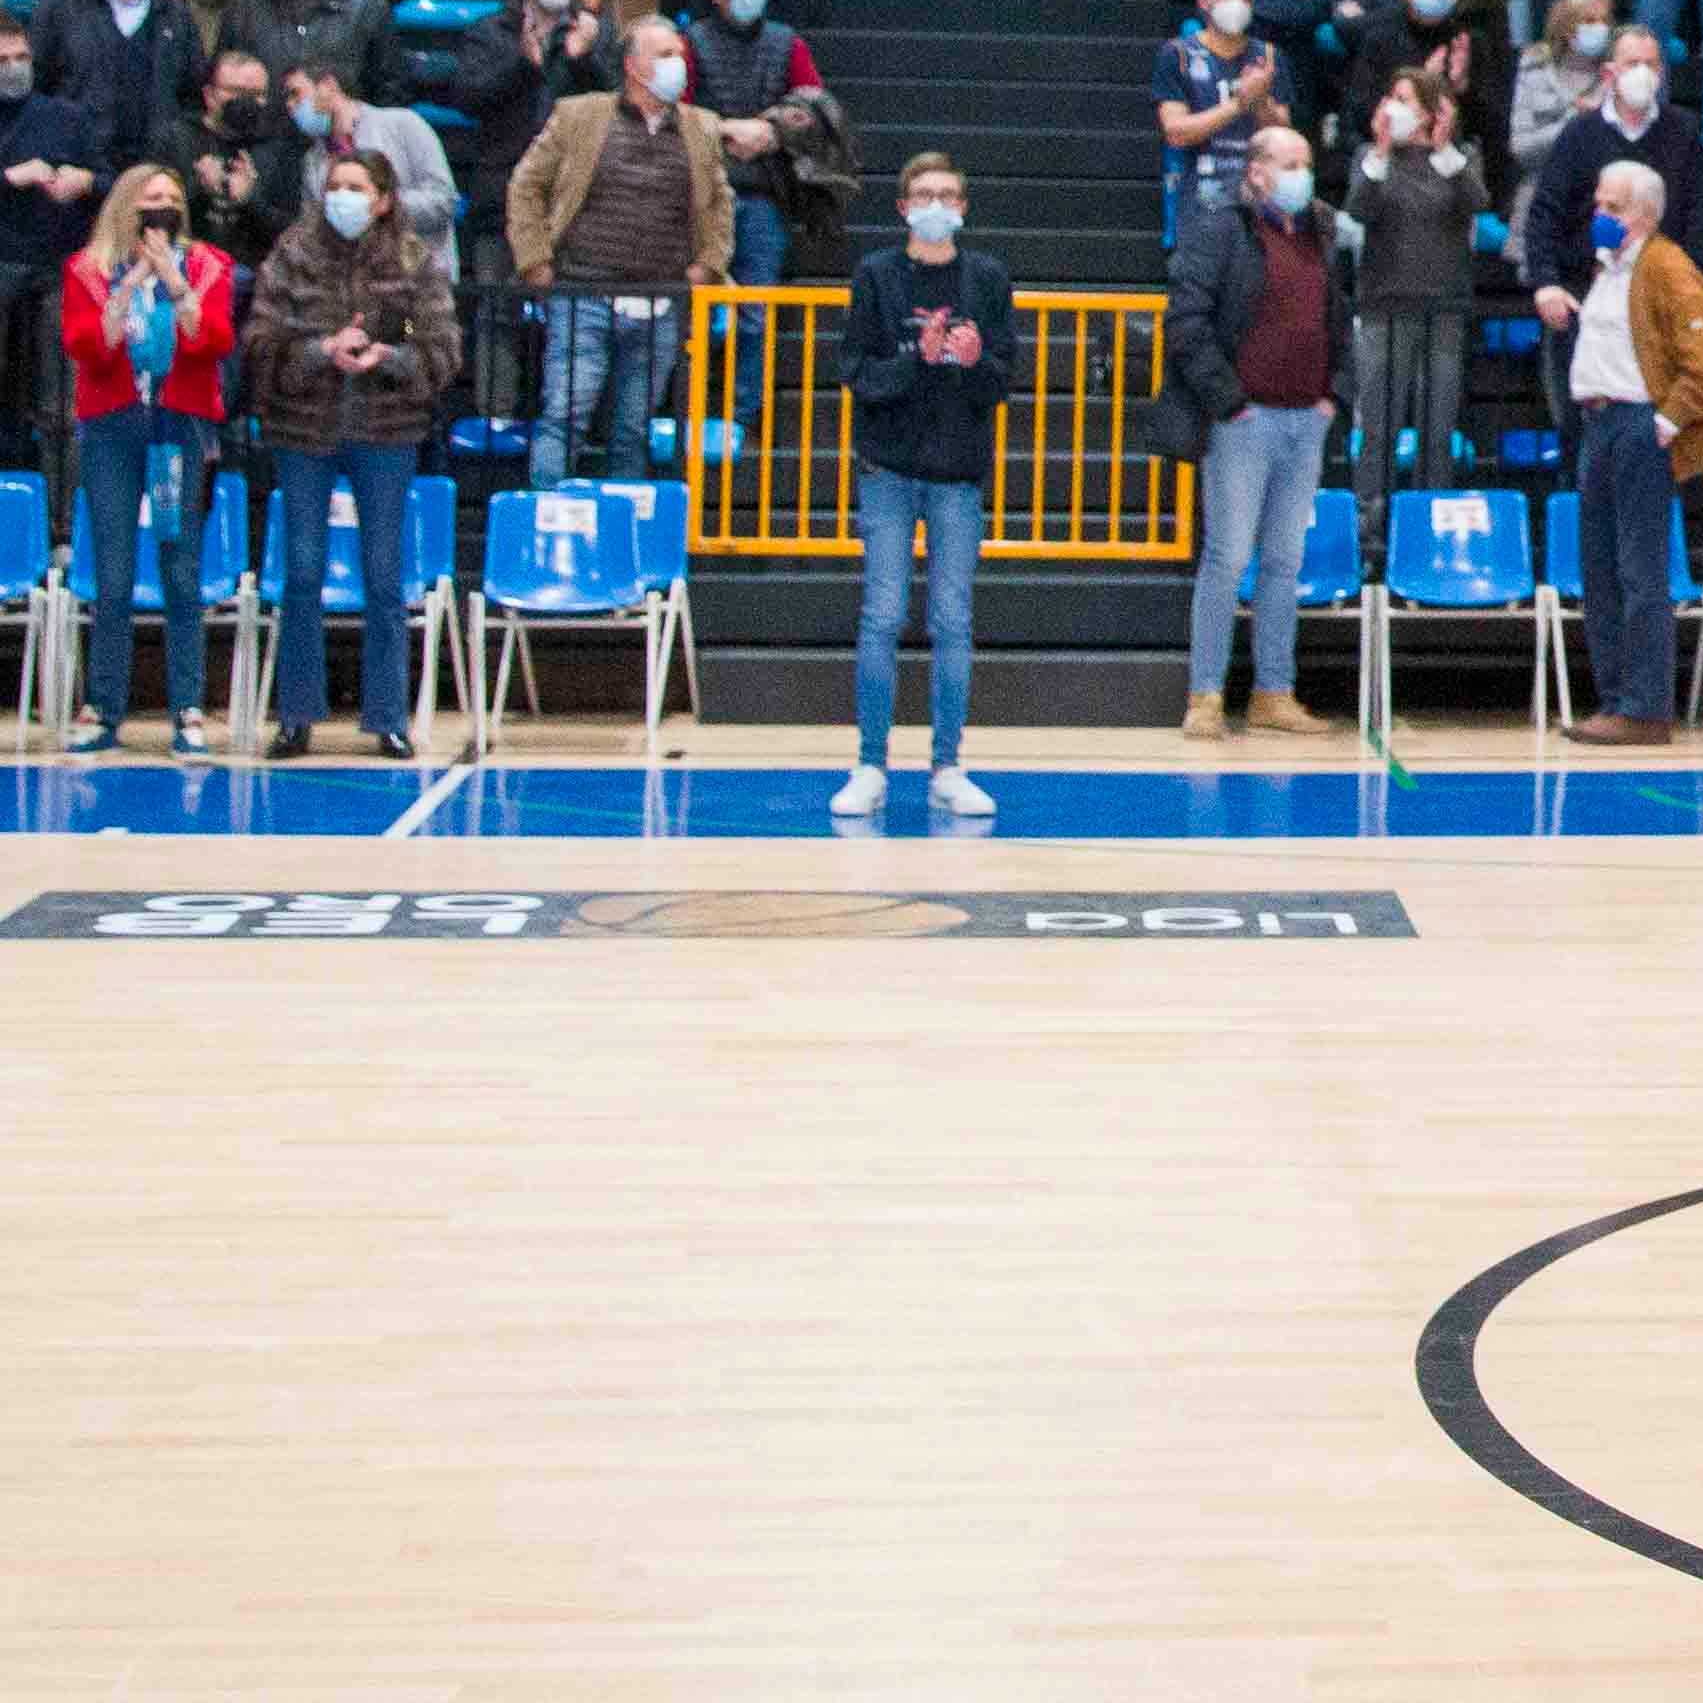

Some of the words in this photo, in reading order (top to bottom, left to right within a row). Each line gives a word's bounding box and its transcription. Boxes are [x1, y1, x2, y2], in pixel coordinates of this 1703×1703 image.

[143, 893, 545, 914] ORO
[93, 910, 529, 936] LEB
[1026, 907, 1358, 936] Liga
